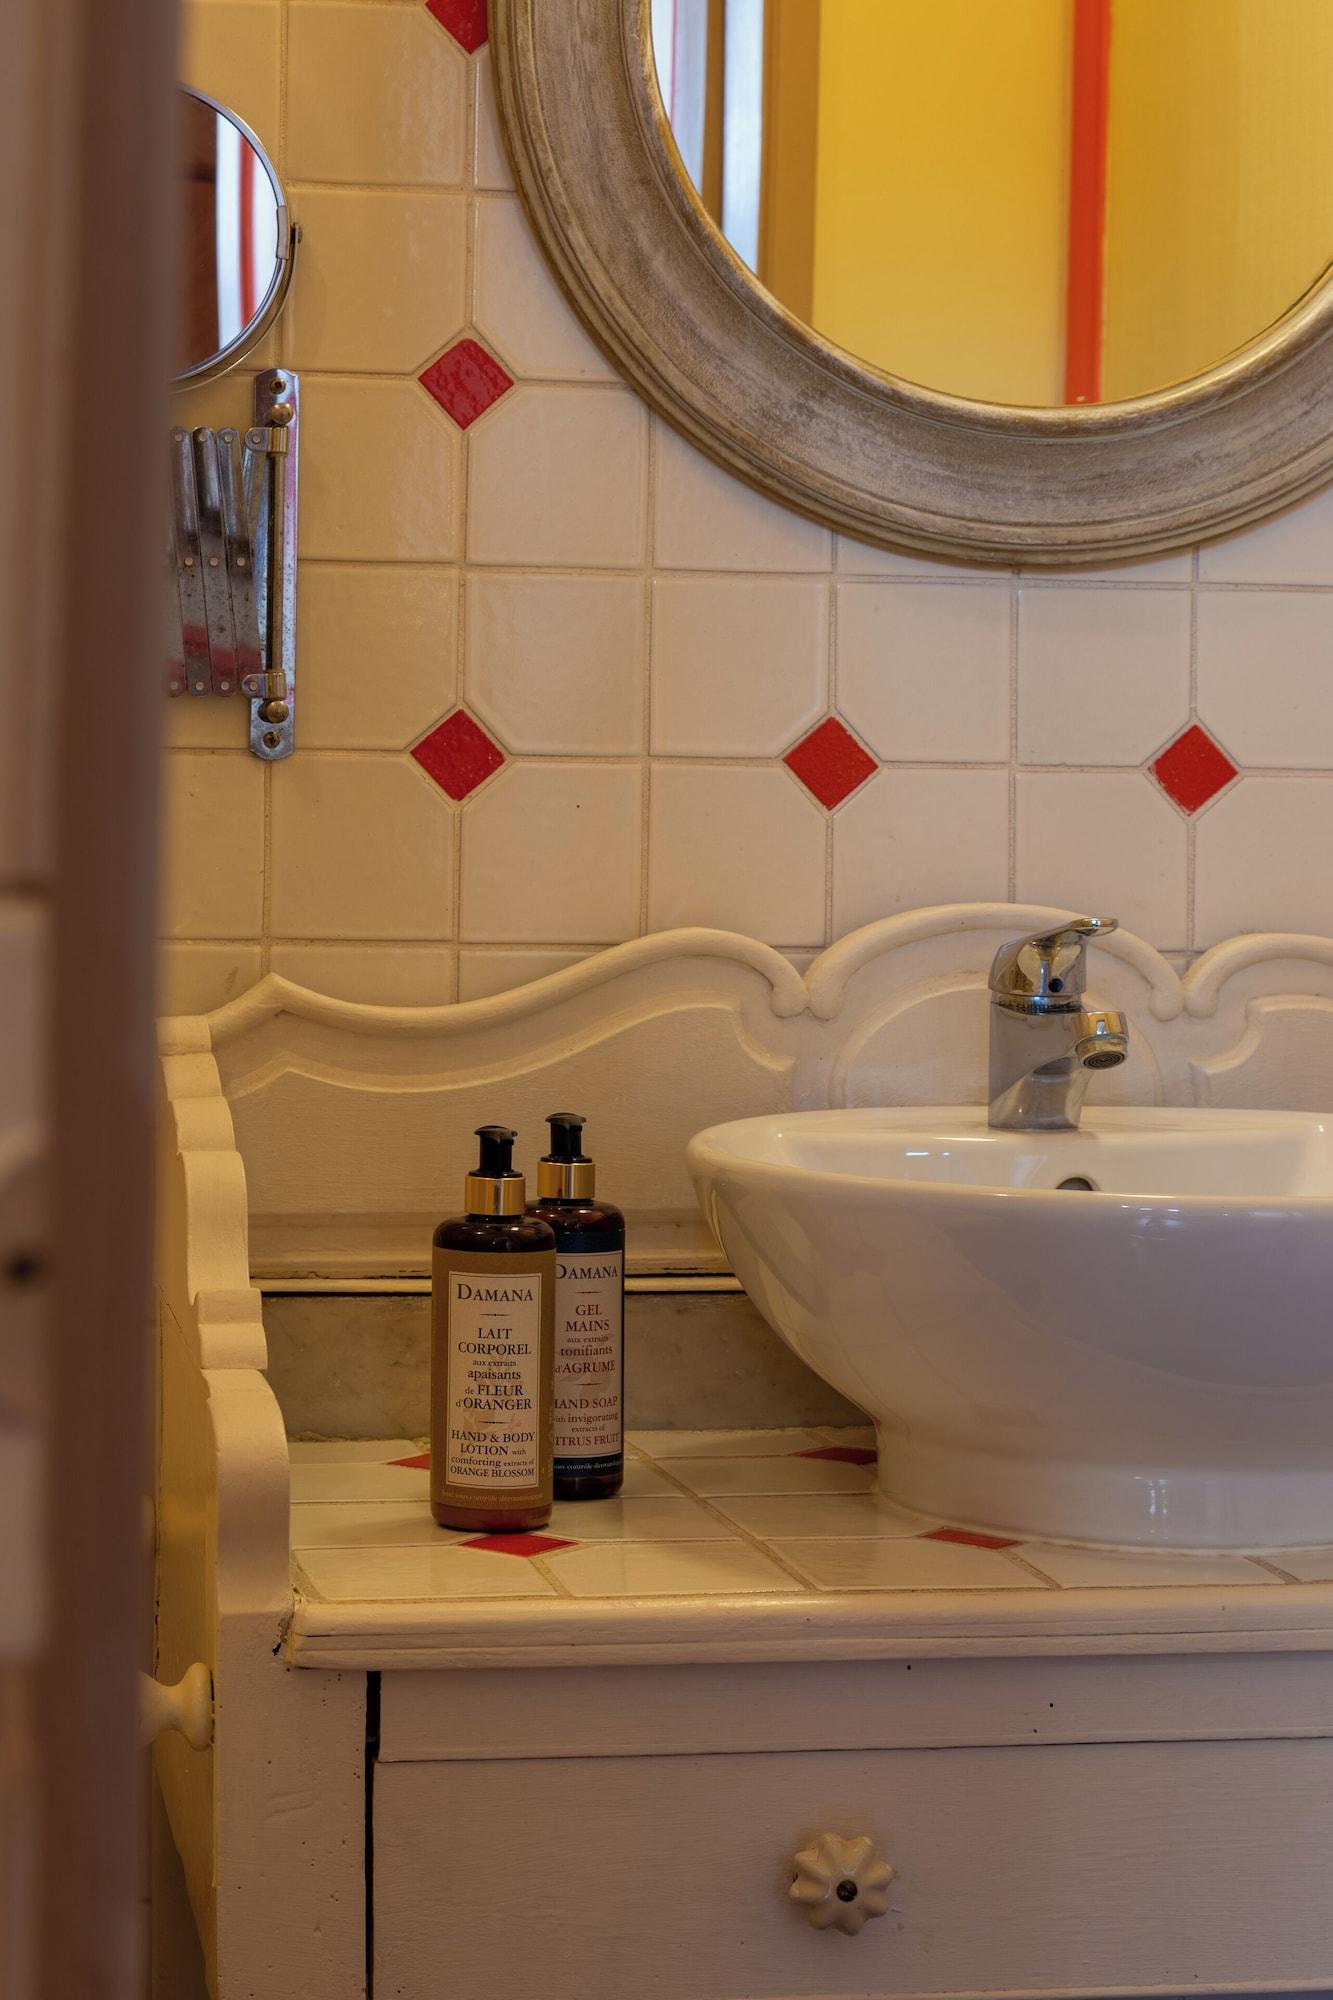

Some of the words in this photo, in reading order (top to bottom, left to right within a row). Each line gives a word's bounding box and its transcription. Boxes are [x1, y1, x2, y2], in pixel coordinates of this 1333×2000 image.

[457, 1283, 533, 1301] DAMANA
[575, 1304, 602, 1316] GEL
[566, 1320, 610, 1332] MAINS
[478, 1328, 512, 1339] LAIT
[458, 1342, 531, 1355] CORPOREL
[561, 1344, 613, 1357] tonifiants
[468, 1368, 521, 1381] apaisants
[465, 1387, 474, 1395] de
[477, 1384, 523, 1396] FLEUR
[456, 1398, 532, 1411] d'ORANGER
[592, 1396, 618, 1409] SOAP
[568, 1411, 618, 1424] invigorating
[451, 1430, 486, 1441] HAND
[490, 1434, 499, 1443] &
[503, 1432, 535, 1443] BODY
[556, 1435, 592, 1446] ITRUS
[460, 1443, 508, 1455] LOTION
[451, 1457, 501, 1468] comforting
[450, 1466, 489, 1477] ORANGE
[492, 1468, 535, 1478] BLOSSOM
